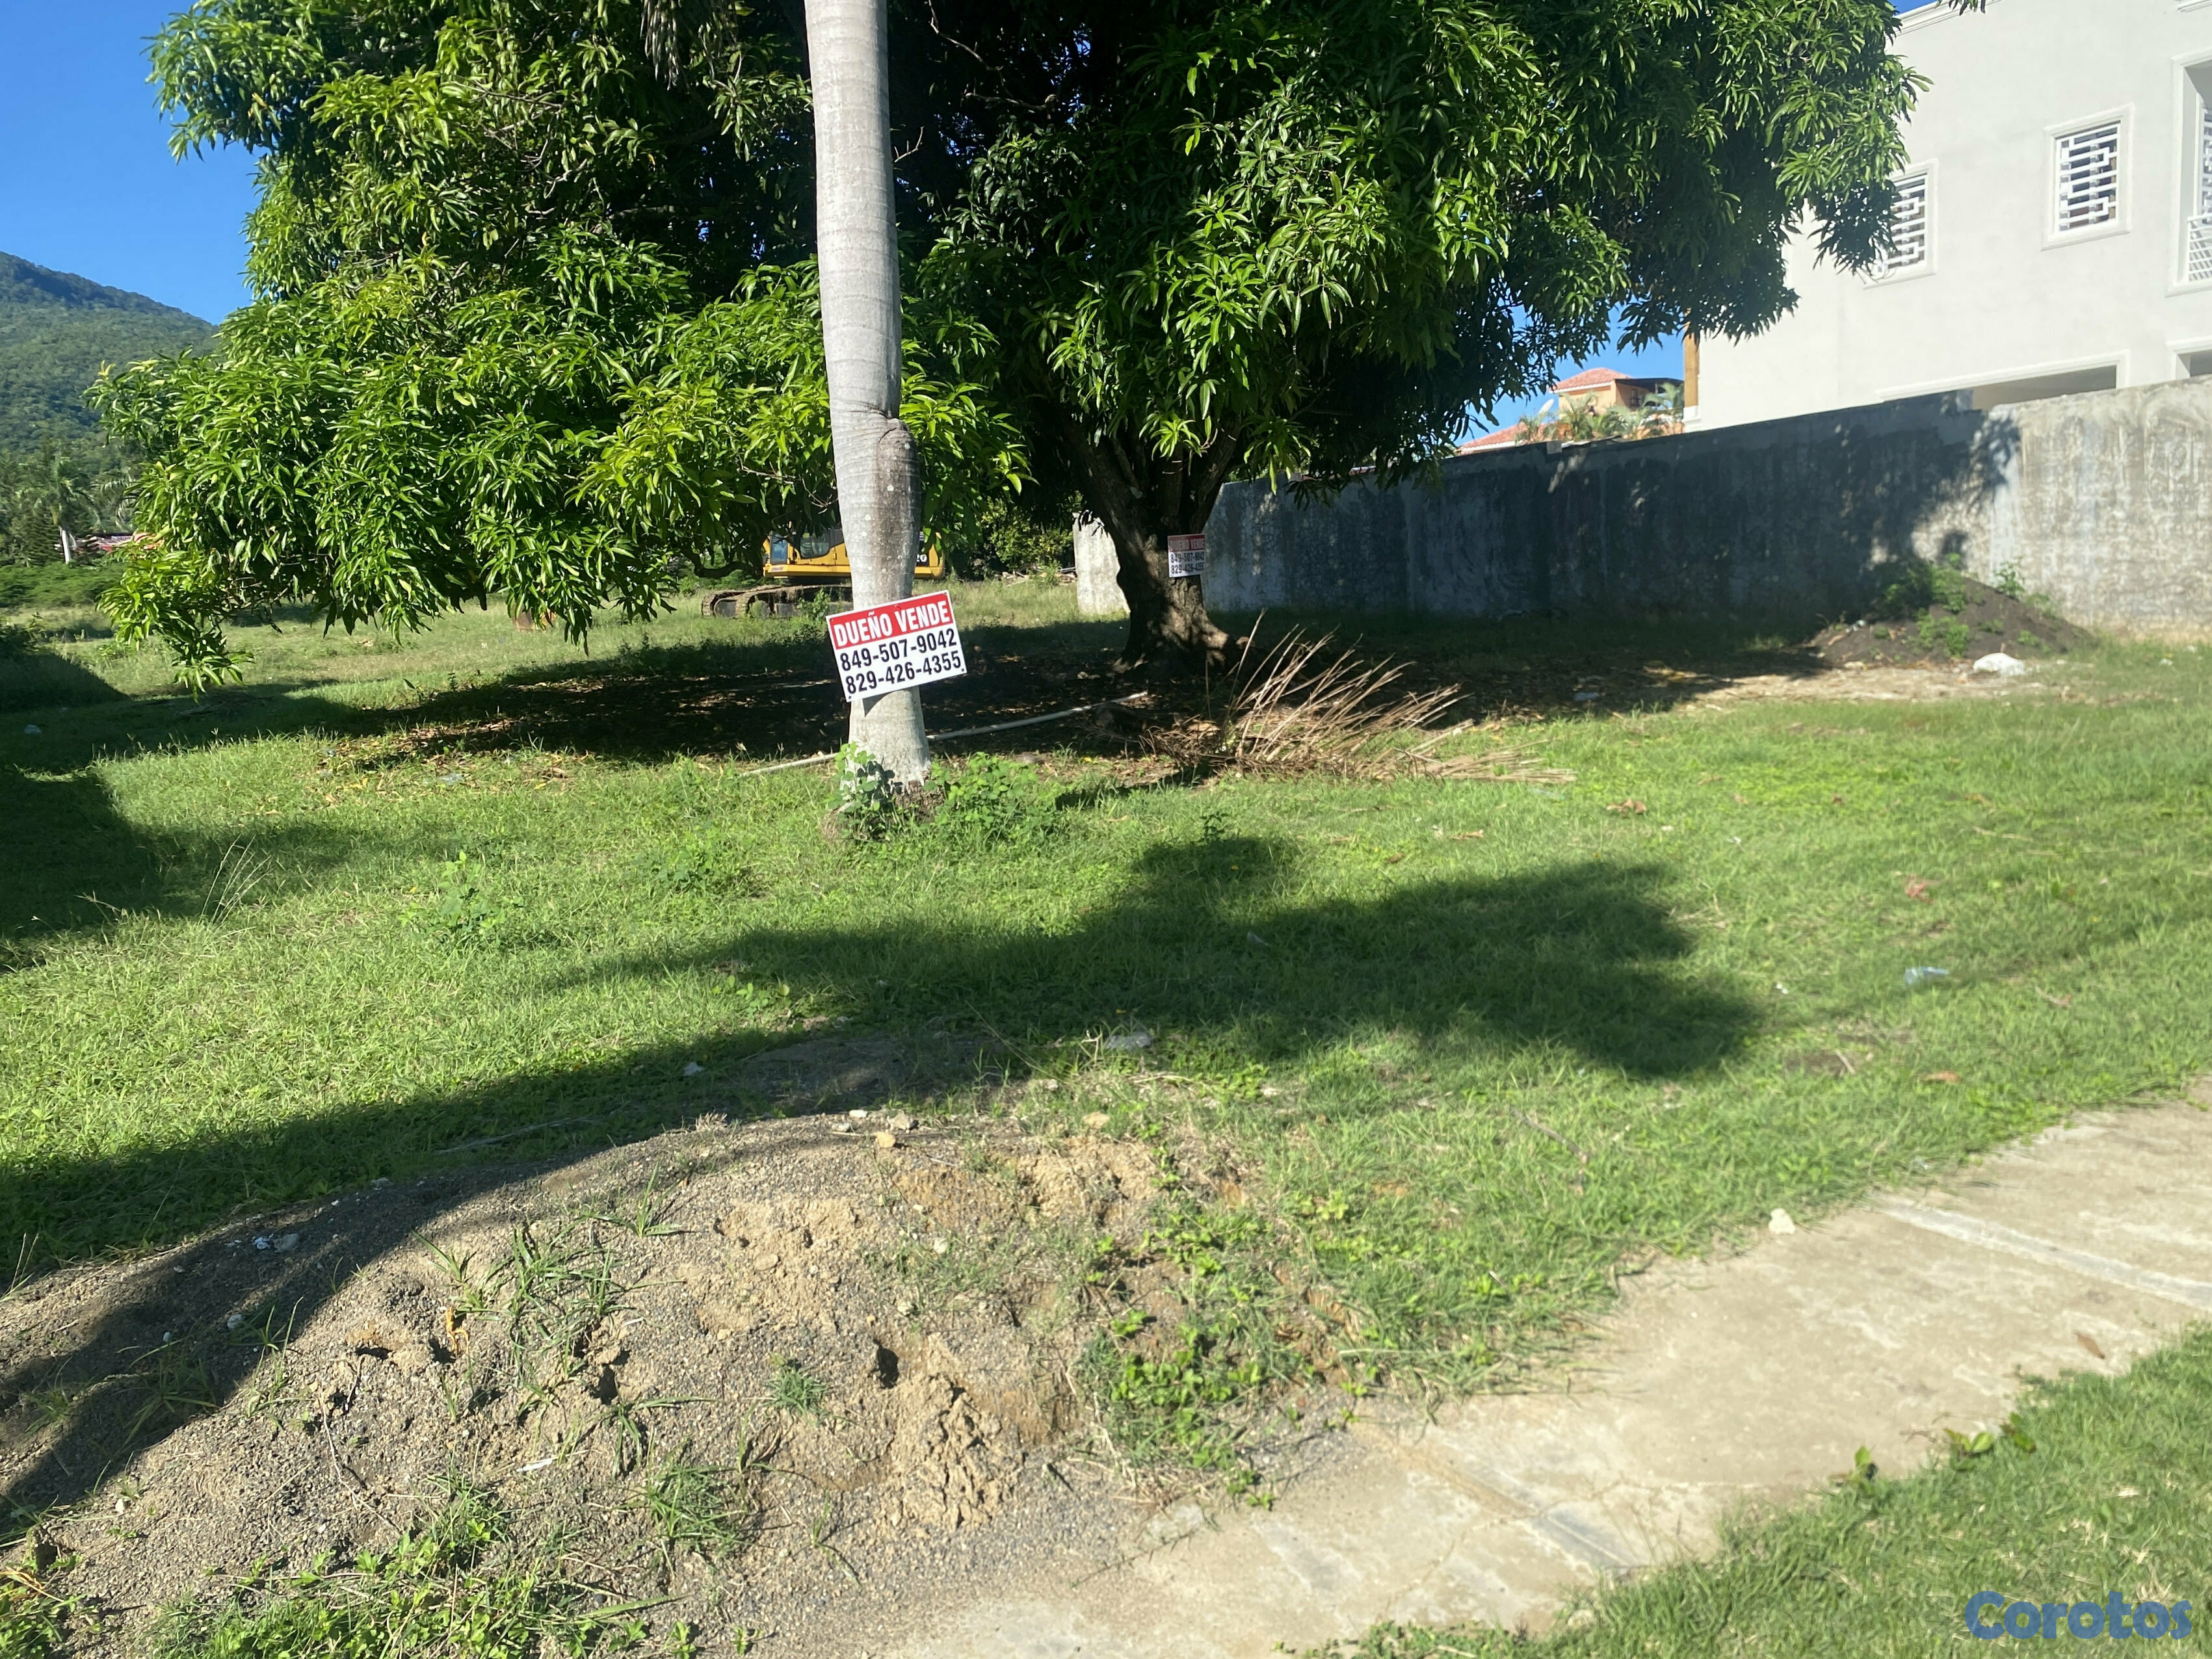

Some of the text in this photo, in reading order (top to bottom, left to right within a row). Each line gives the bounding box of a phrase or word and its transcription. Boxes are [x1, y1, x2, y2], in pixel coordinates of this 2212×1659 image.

[834, 600, 951, 647] DUEÑO VENDE
[839, 628, 957, 672] 849-507-9042
[845, 650, 961, 694] 829-426-4355
